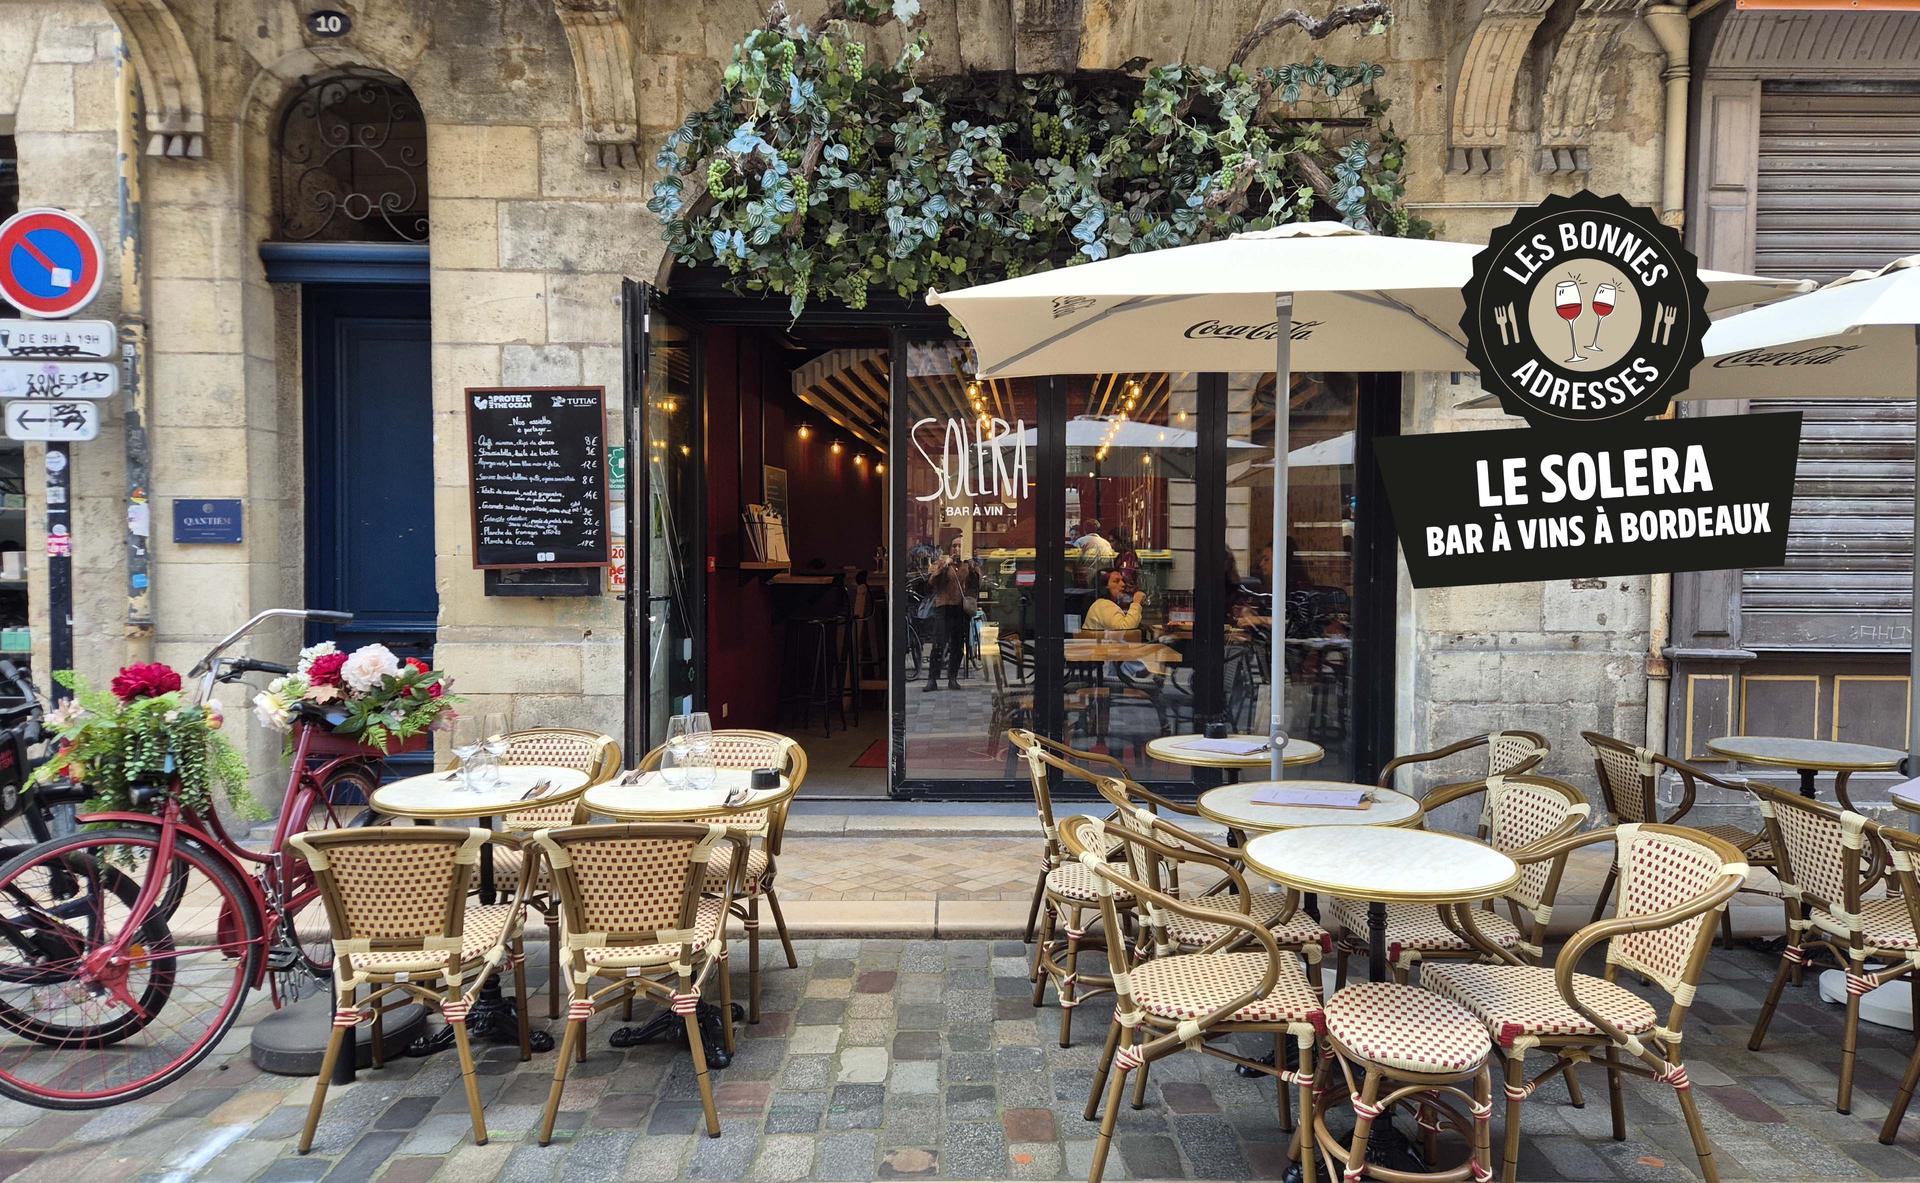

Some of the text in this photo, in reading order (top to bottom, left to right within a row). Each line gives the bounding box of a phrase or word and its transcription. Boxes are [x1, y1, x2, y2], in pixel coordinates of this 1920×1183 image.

[316, 15, 341, 32] 10
[19, 334, 35, 343] DE
[42, 334, 57, 343] 9H
[566, 397, 598, 405] TUTIAC
[911, 417, 1029, 502] SOLERA
[945, 504, 1004, 516] BAR À VIN
